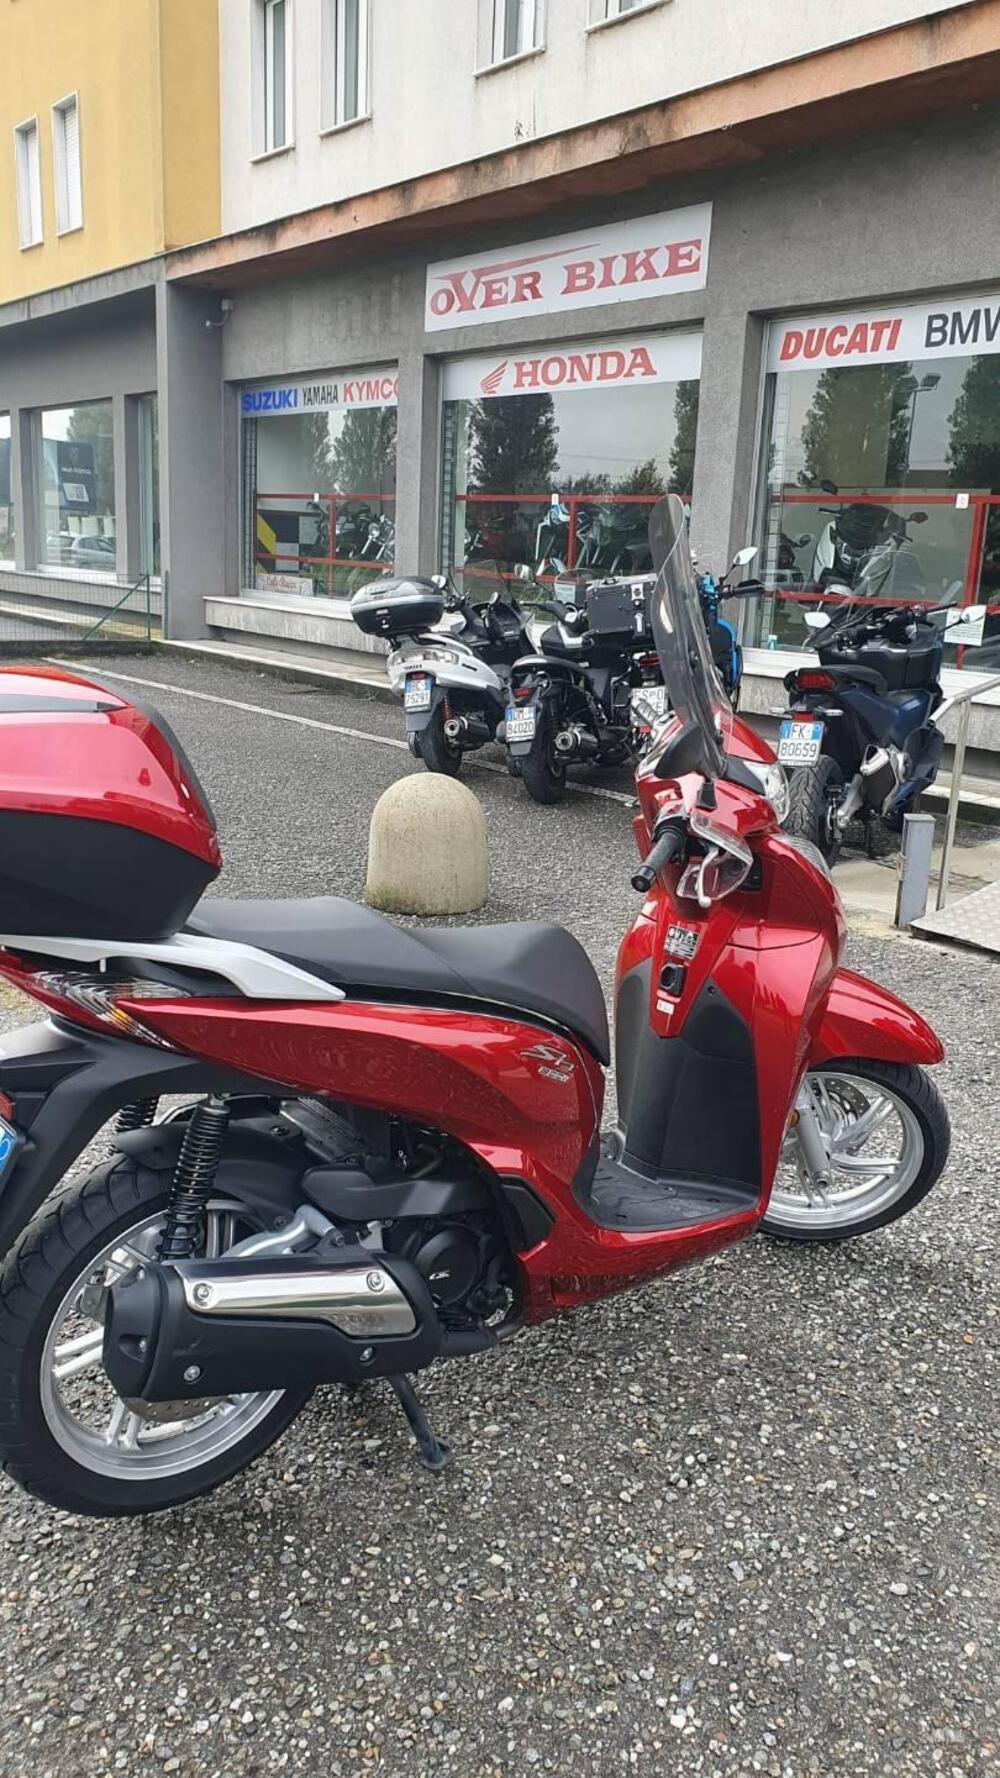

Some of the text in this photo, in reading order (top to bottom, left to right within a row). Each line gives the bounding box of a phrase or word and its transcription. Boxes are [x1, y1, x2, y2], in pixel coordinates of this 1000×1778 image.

[430, 239, 702, 316] OVER BIKE
[779, 318, 903, 361] DUCATI
[513, 347, 658, 389] HONDA
[242, 388, 299, 413] SUZUKI
[302, 384, 339, 406] YAMAHA
[791, 724, 806, 739] FK
[780, 742, 817, 758] 80659
